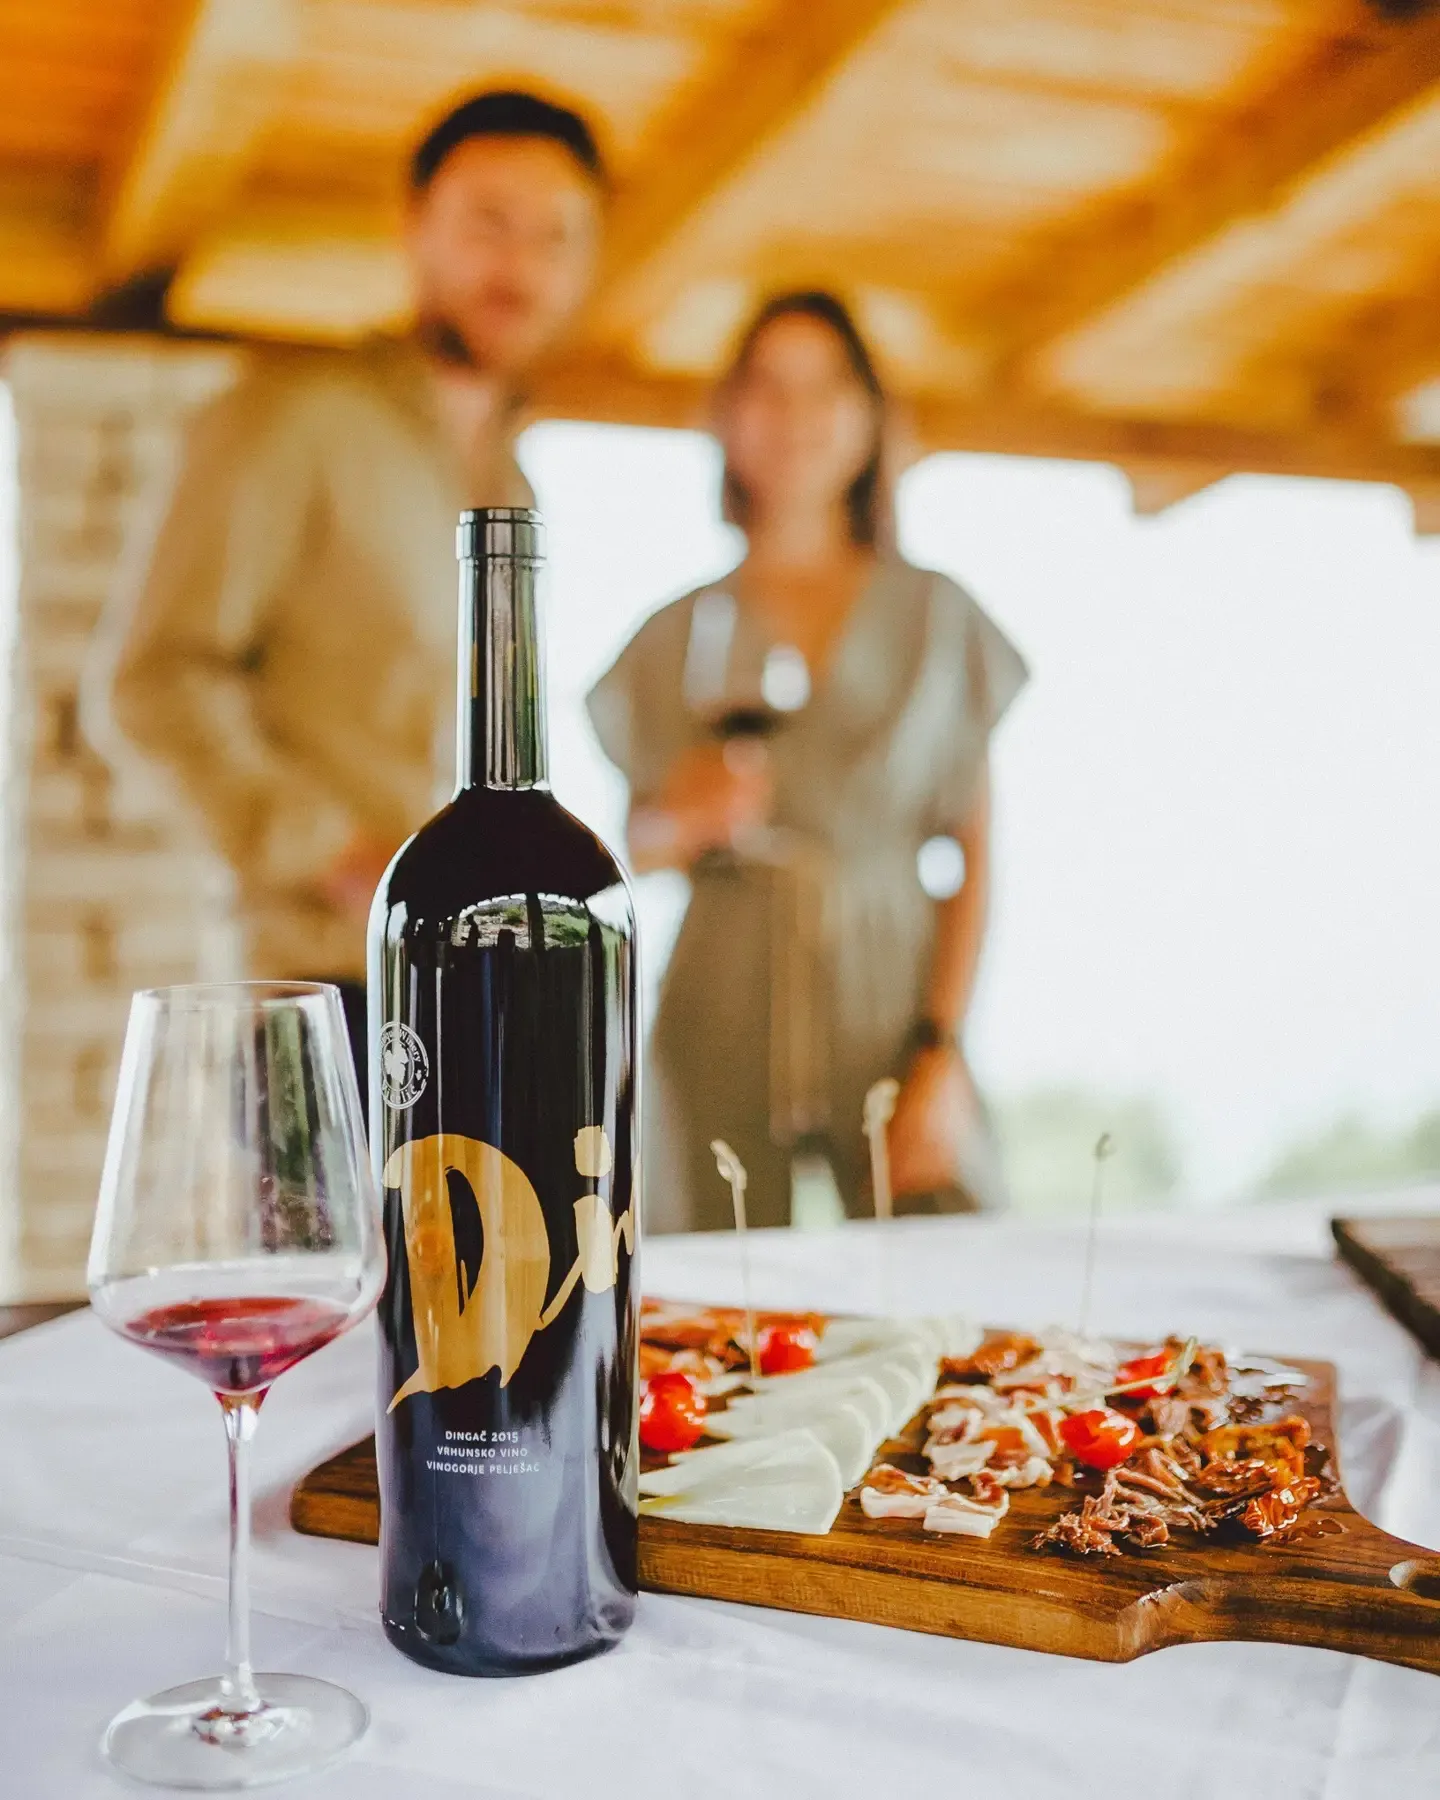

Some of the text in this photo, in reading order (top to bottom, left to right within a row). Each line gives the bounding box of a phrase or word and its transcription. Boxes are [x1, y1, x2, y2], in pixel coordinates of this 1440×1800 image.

[399, 1028, 421, 1063] Winery
[445, 1430, 519, 1443] DINGAČ 2015
[437, 1446, 528, 1459] VRHUNSKO VINO
[426, 1460, 540, 1475] VINOGORJE PELJEŠAC
